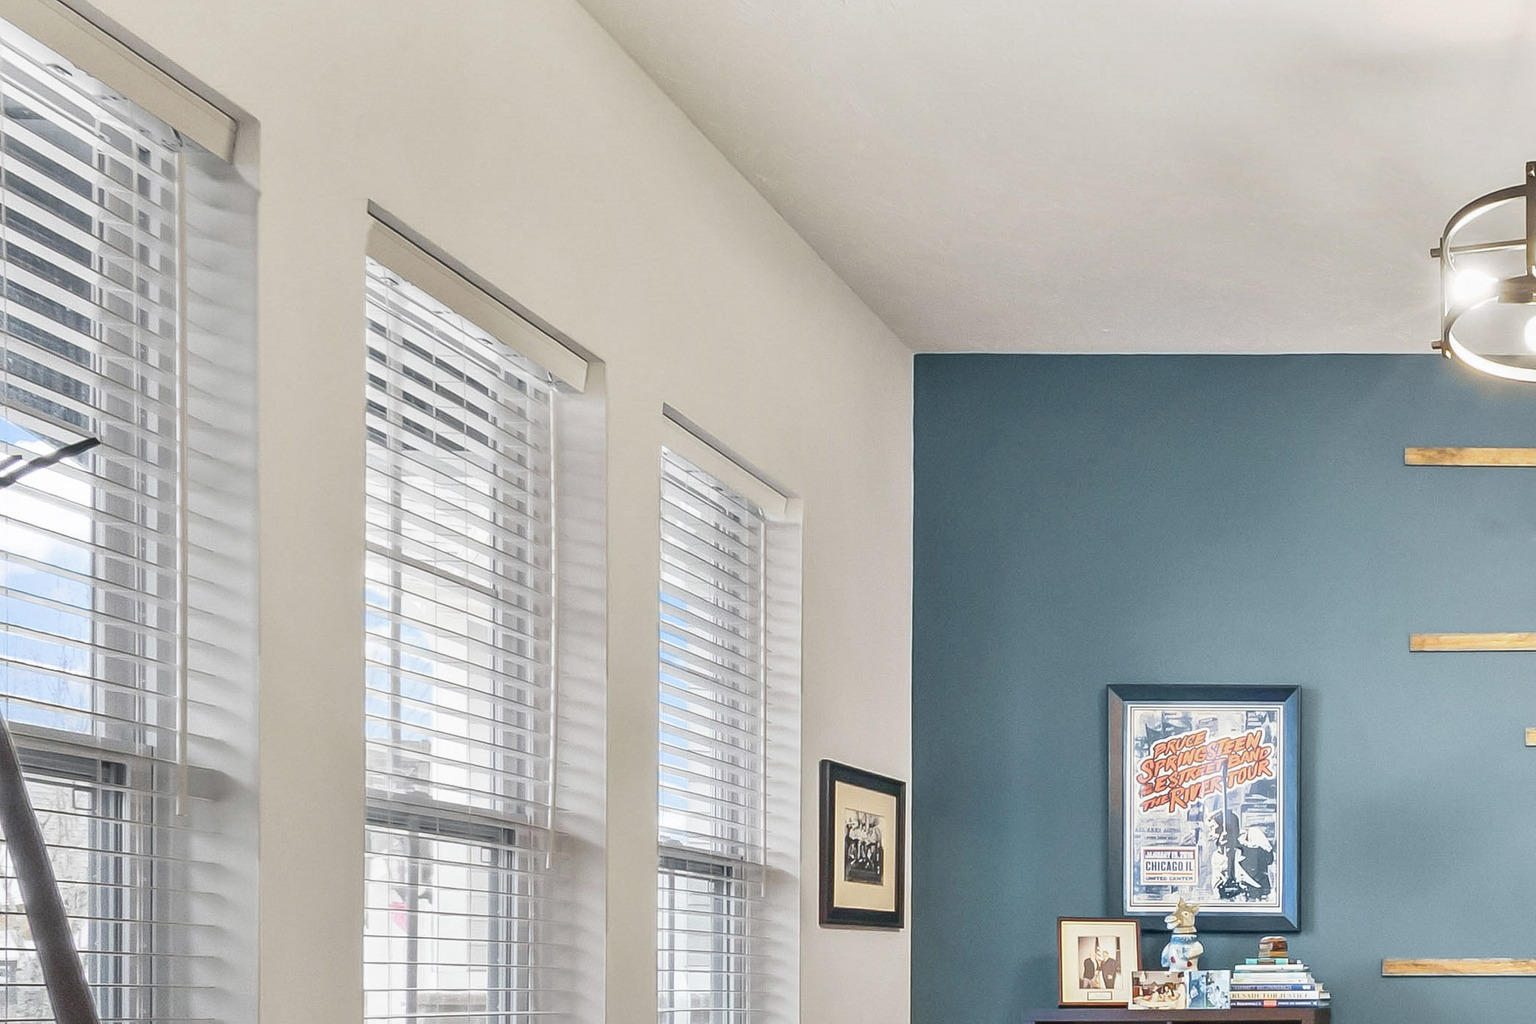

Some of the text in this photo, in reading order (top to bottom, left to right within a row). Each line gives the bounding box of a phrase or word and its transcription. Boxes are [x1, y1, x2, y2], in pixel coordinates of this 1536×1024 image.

[1136, 730, 1262, 784] SPRINGSTEEN
[1153, 730, 1207, 759] BRUCE
[1142, 759, 1273, 813] THE RIVER TOUR
[1154, 775, 1169, 793] E
[1168, 760, 1224, 789] STREET
[1227, 746, 1272, 769] BAND
[1185, 862, 1193, 871] IL
